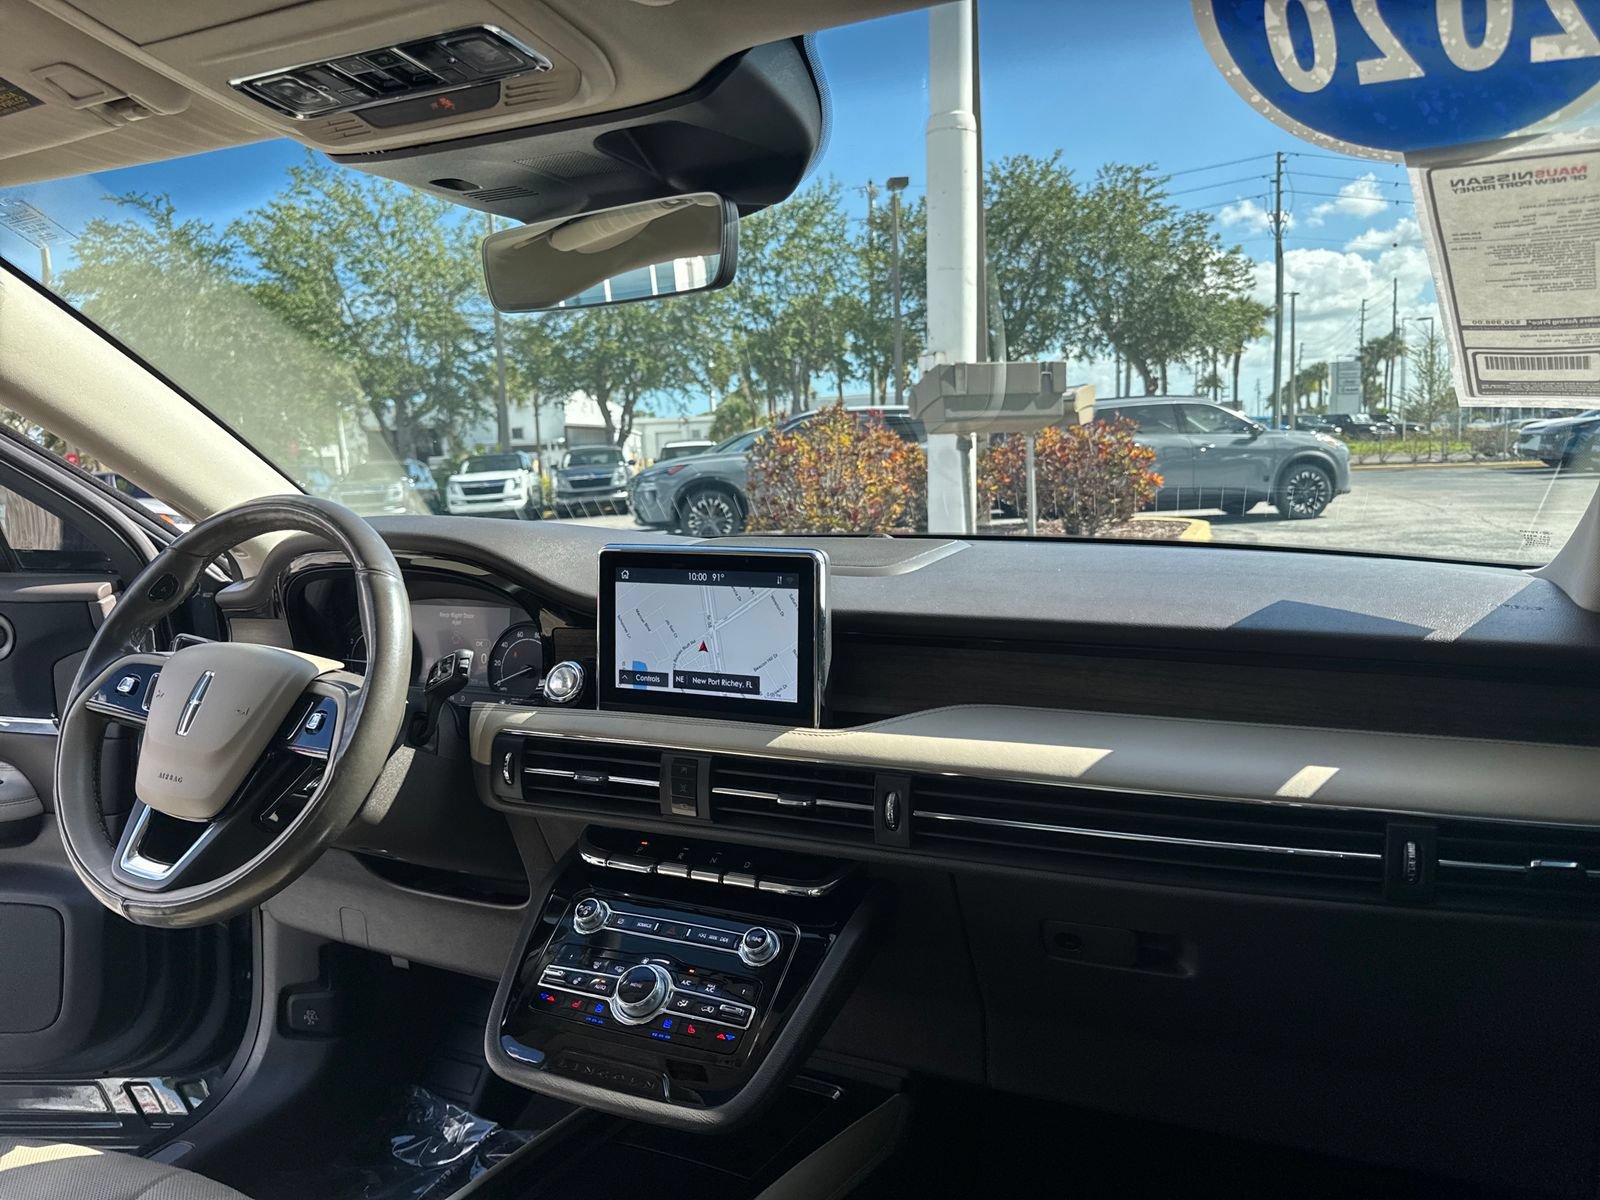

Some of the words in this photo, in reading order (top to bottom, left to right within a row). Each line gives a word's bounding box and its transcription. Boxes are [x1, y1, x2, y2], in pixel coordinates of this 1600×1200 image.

[688, 572, 708, 581] 10:00
[712, 573, 725, 582] 91°
[635, 674, 660, 683] Controls
[708, 678, 720, 686] Port
[721, 679, 745, 688] Richey,
